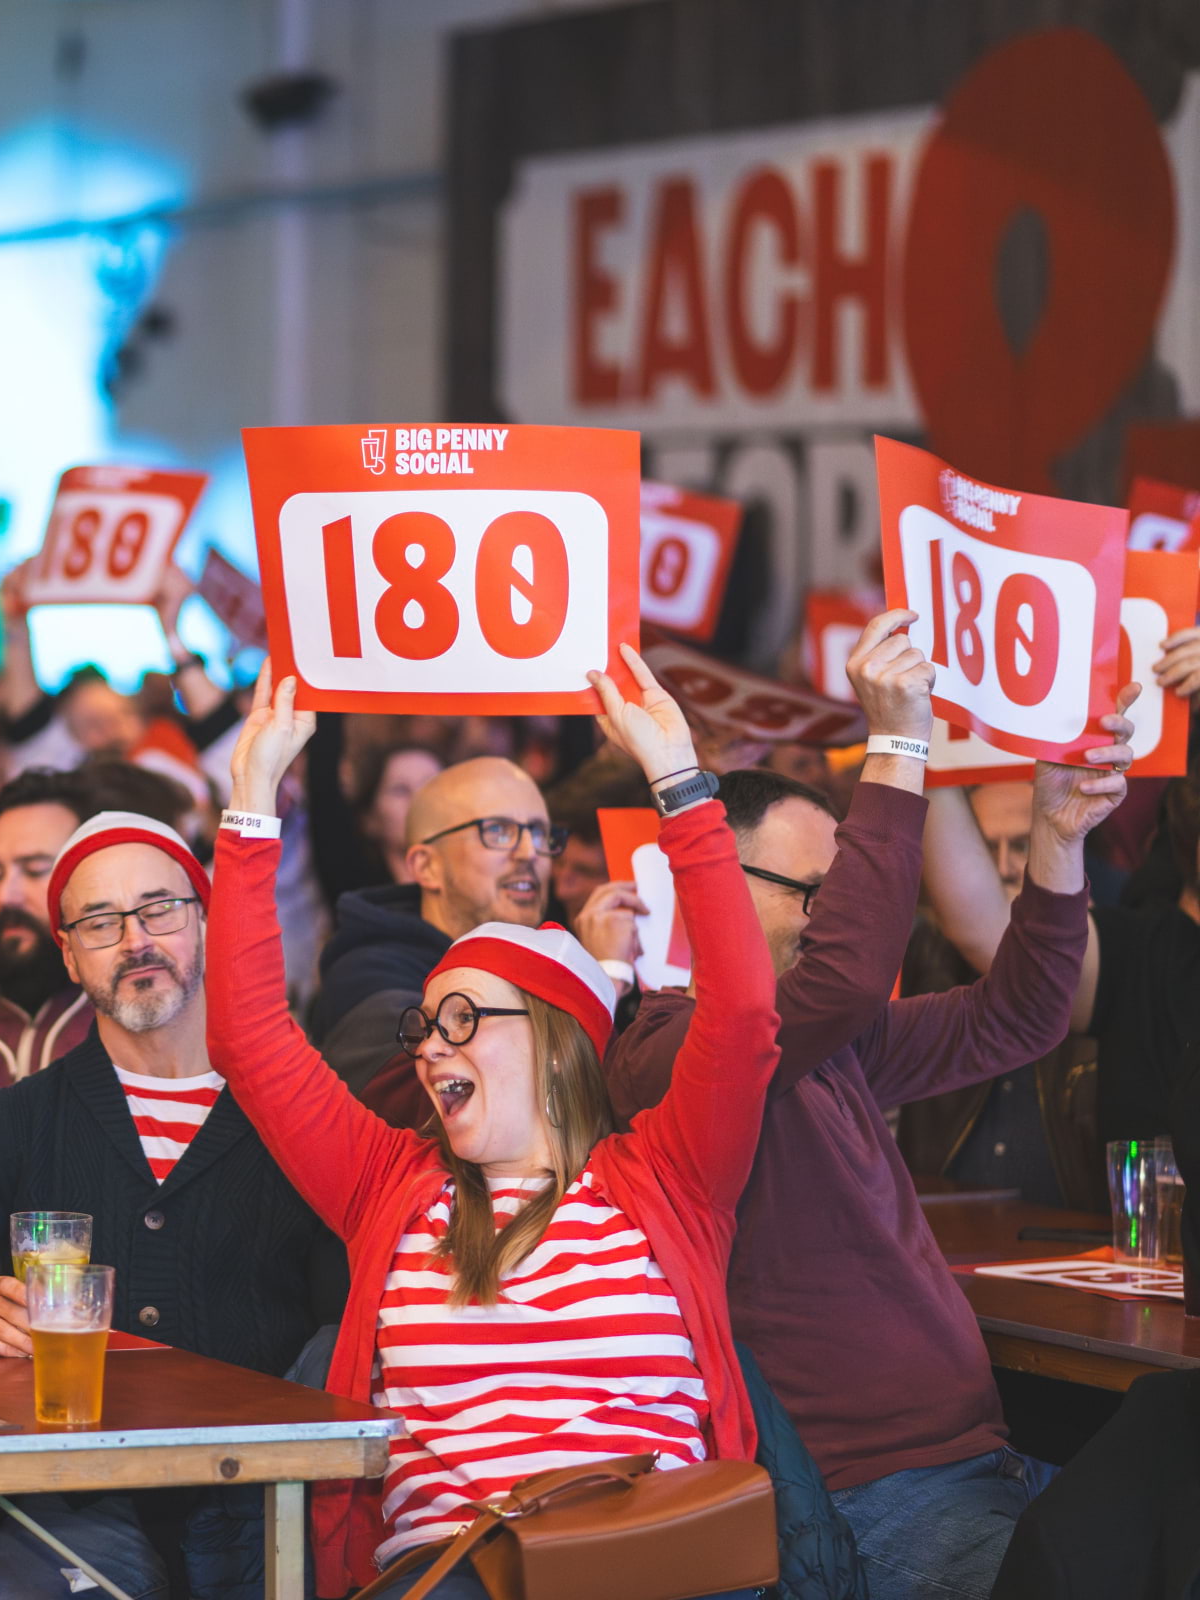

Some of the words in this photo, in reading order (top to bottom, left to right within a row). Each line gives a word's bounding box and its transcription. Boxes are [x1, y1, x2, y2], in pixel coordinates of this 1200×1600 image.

[569, 150, 894, 408] EACH
[395, 429, 432, 450] BIG
[436, 429, 509, 451] PENNY
[395, 452, 474, 475] SOCIAL
[322, 511, 569, 660] 180
[929, 539, 1060, 706] 180
[890, 739, 921, 753] SOCIAL
[246, 817, 261, 828] BIG
